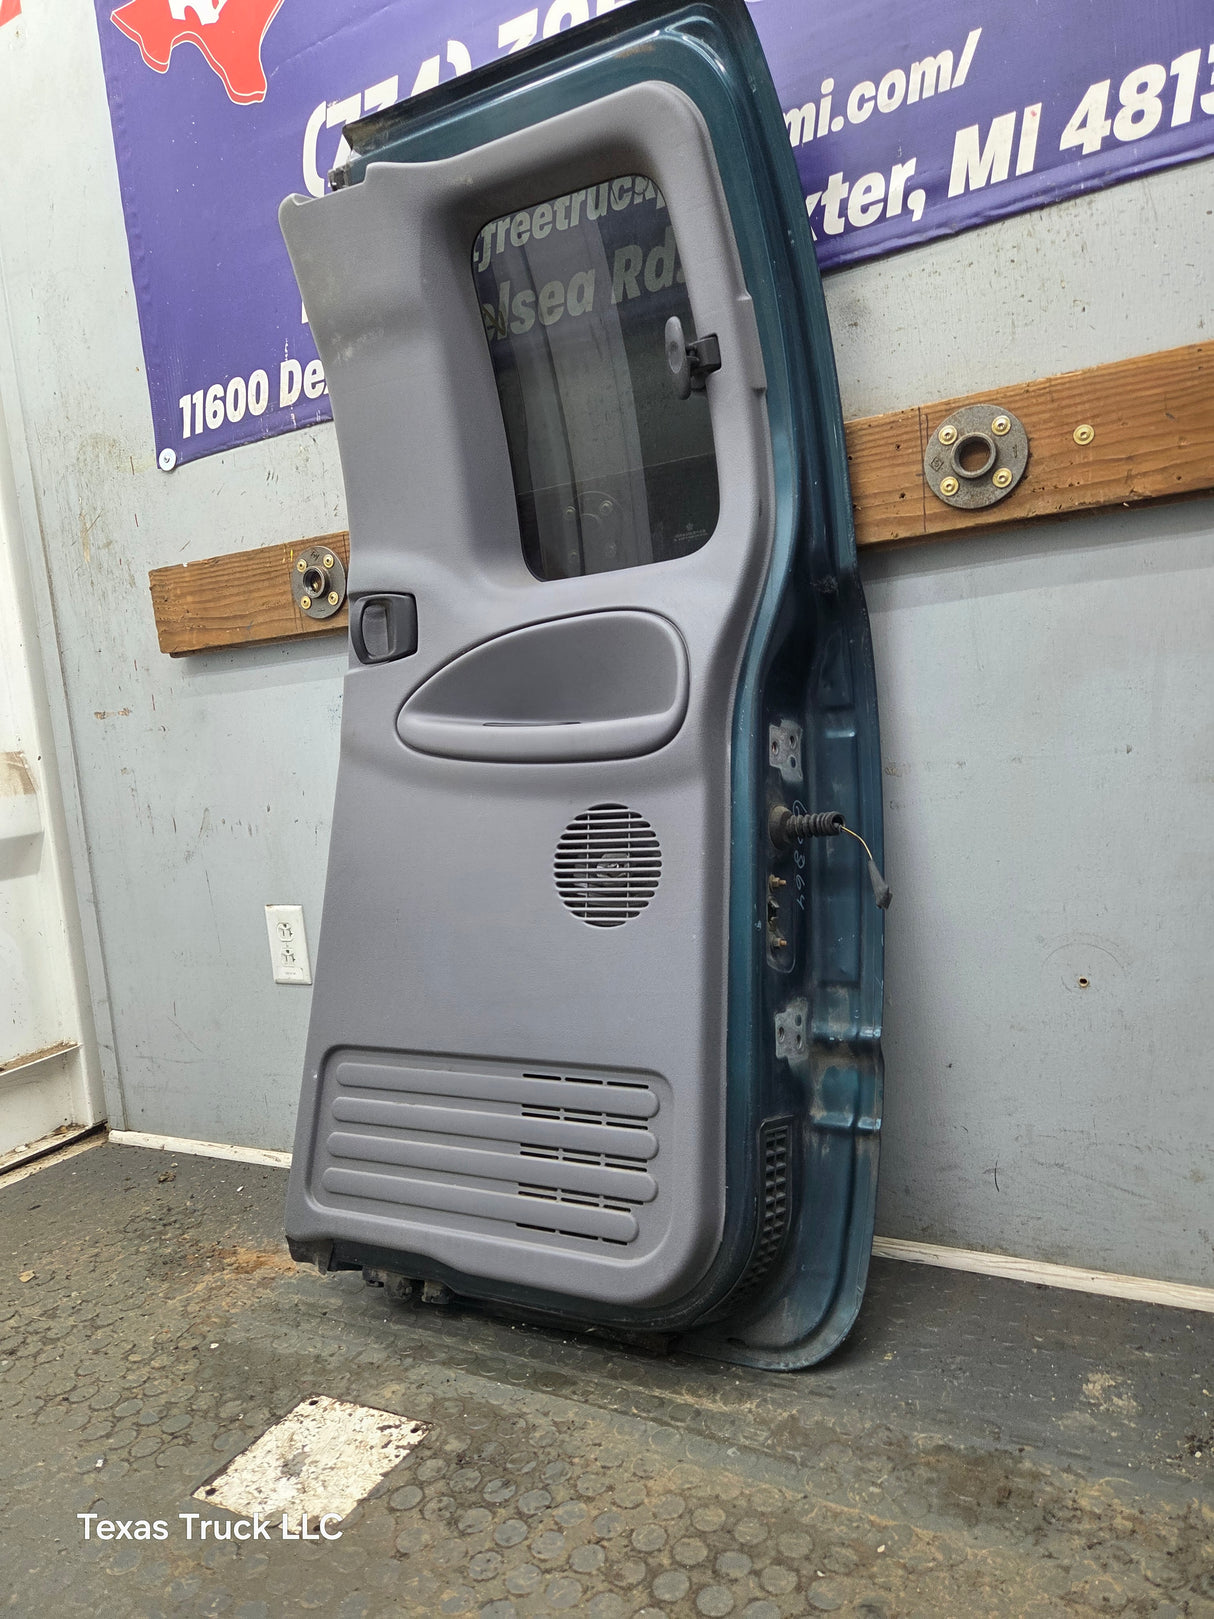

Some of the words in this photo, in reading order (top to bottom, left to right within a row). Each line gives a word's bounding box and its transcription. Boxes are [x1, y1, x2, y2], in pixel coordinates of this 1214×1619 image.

[179, 369, 269, 439] 11600
[280, 358, 328, 408] De
[947, 102, 1042, 198] MI
